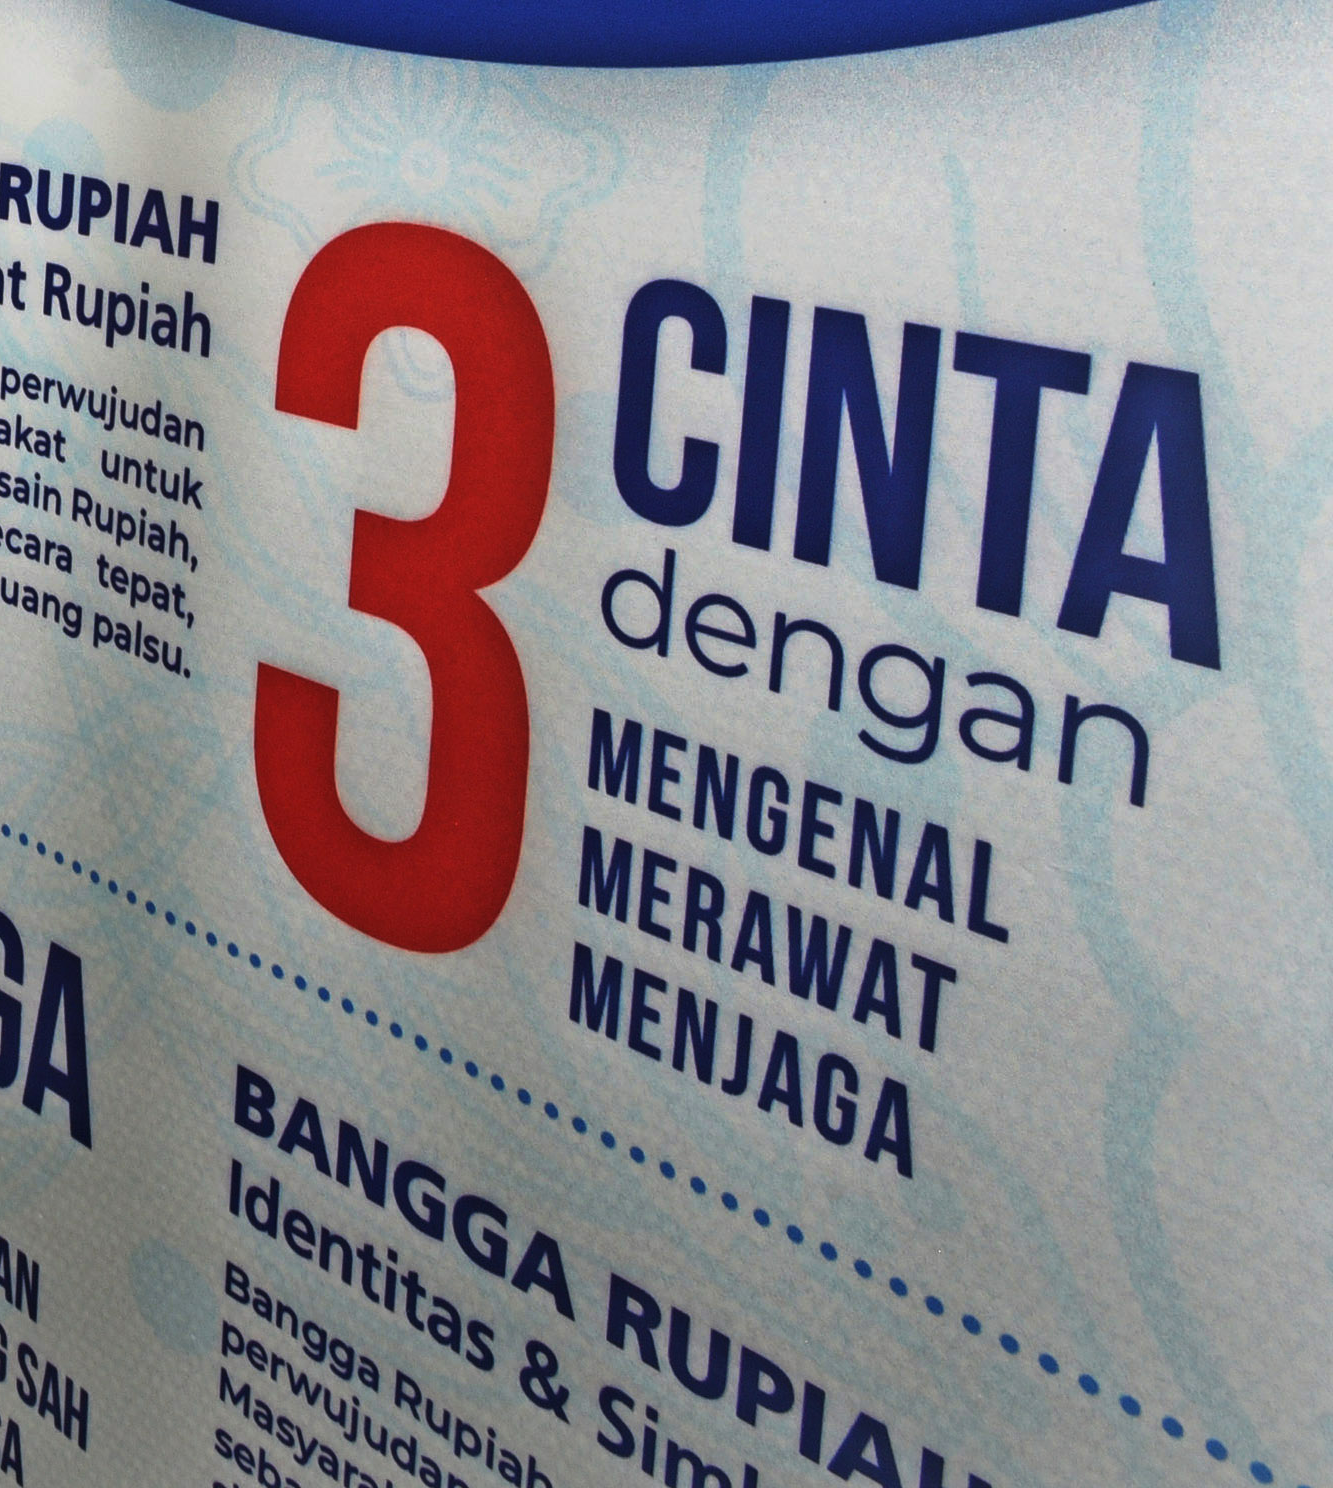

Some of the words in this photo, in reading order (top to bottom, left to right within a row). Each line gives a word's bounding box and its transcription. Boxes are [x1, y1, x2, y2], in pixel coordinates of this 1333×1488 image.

[43, 262, 211, 358] Rupiah
[1, 366, 204, 453] perwujudan
[613, 278, 1222, 671] CINTA
[72, 487, 198, 573] Rupiah,
[101, 450, 203, 510] untuk
[1, 577, 82, 638] uang
[93, 612, 194, 679] palsu.
[97, 554, 198, 629] tepat,
[254, 221, 555, 953] 3
[601, 548, 1150, 808] dengan
[588, 708, 1009, 944] MENGENAL
[579, 821, 958, 1053] MERAWAT
[569, 938, 913, 1180] MENJAGA
[230, 1061, 575, 1323] BANGGA
[222, 1261, 380, 1393] Bangga
[225, 1158, 495, 1372] Identitas
[519, 1340, 570, 1424] &
[17, 1343, 89, 1452] SAH
[219, 1367, 392, 1488] Masyara
